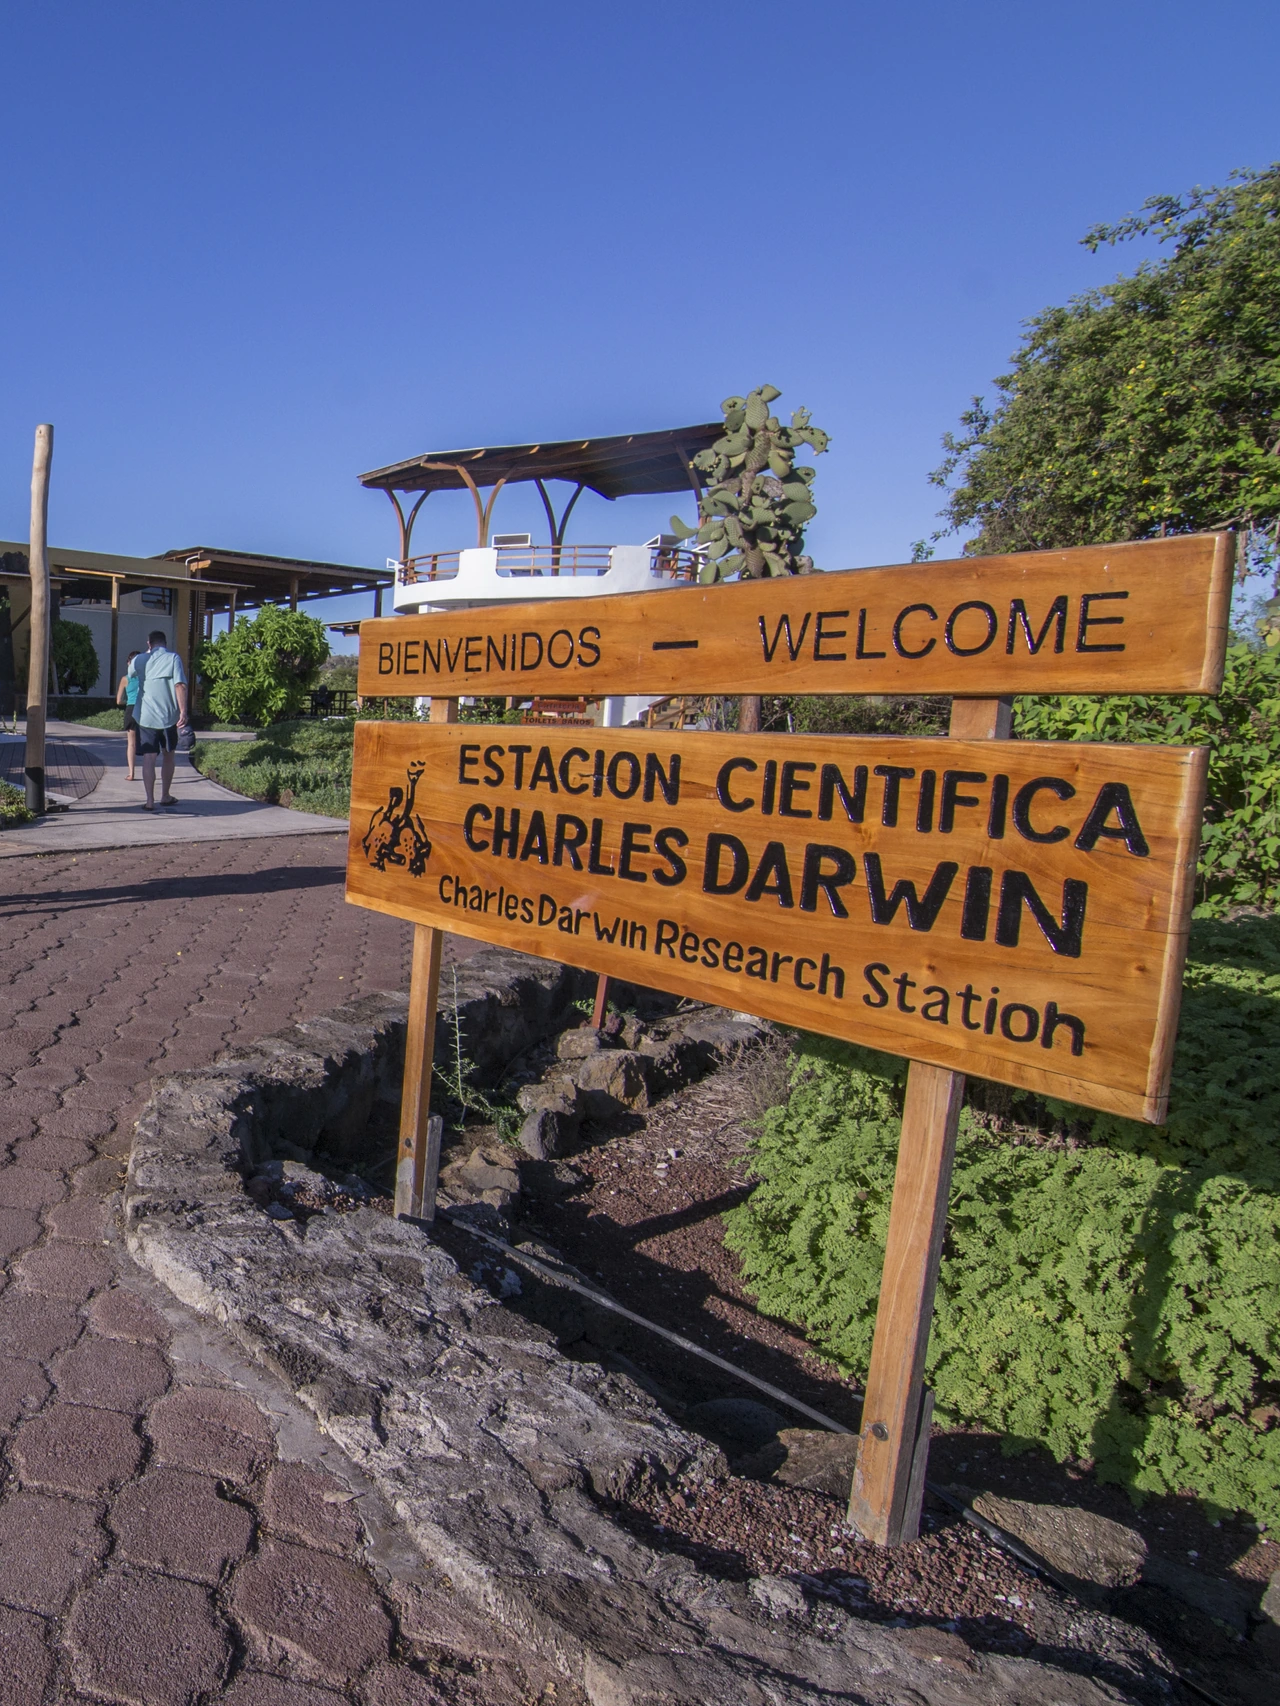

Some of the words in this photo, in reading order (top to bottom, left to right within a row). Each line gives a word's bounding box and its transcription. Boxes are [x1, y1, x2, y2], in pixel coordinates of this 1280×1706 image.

[377, 626, 602, 675] BIENVENIDOS
[758, 591, 1130, 663] WELCOME
[525, 717, 557, 725] TOILETS
[458, 744, 682, 806] ESTACION
[715, 756, 1151, 858] CIENTIFICA
[438, 874, 534, 924] Charles
[538, 893, 648, 952] Darwin
[654, 918, 846, 1000] Research
[463, 802, 690, 887] CHARLES
[702, 832, 1089, 959] DARWIN
